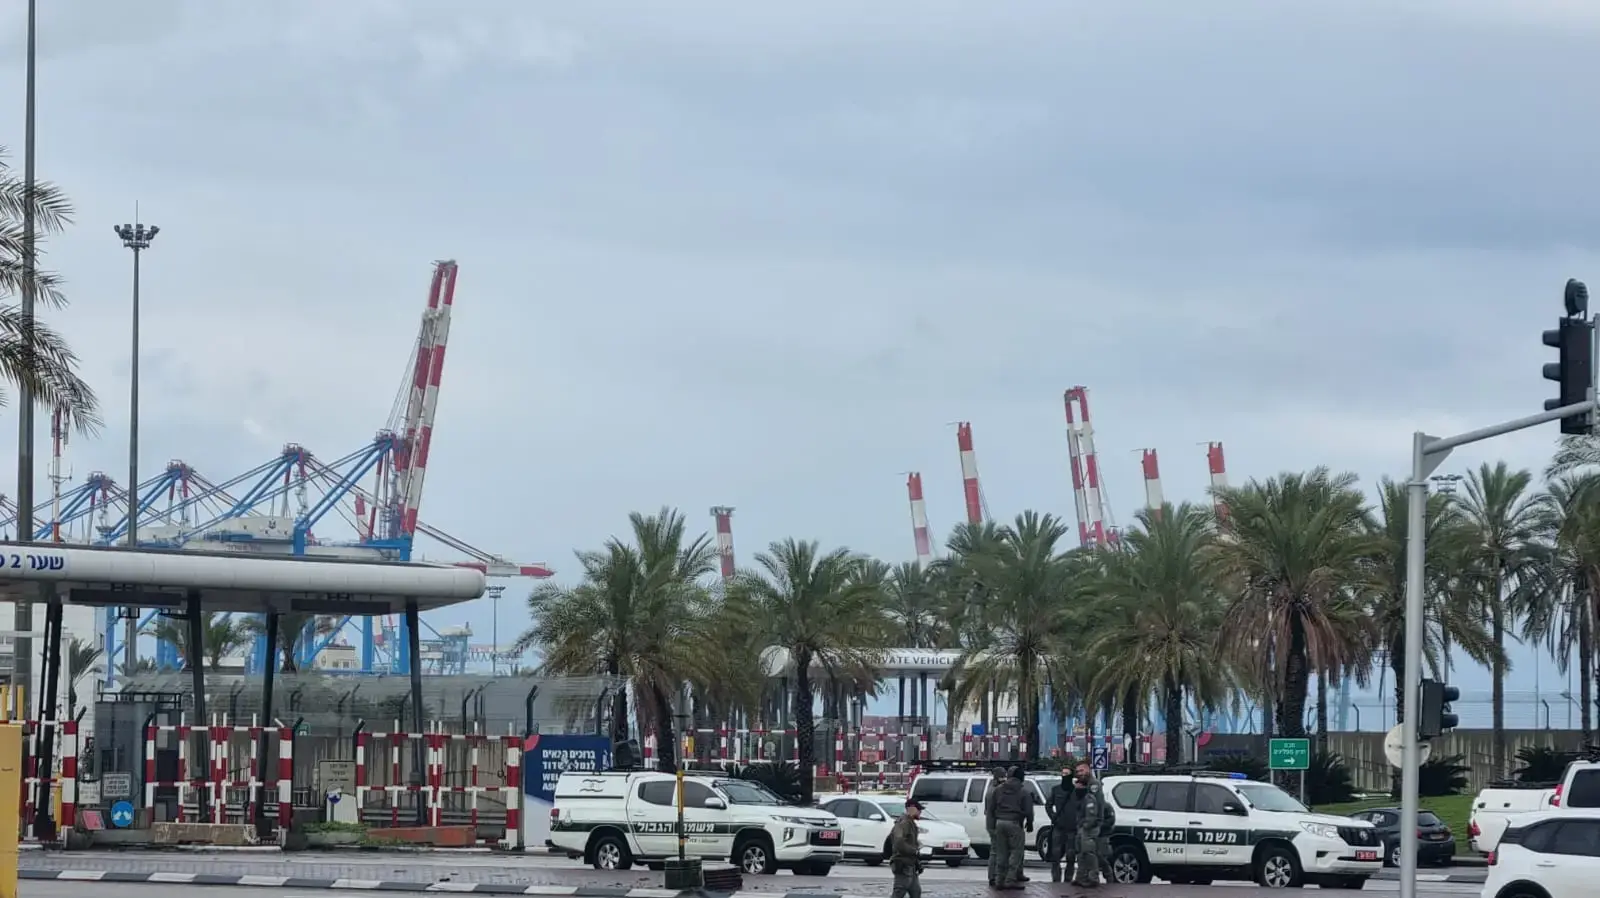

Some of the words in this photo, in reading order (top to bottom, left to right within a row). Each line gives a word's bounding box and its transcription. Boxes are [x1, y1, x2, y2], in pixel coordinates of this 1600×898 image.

[10, 554, 21, 569] 2
[27, 554, 65, 571] שער
[569, 750, 596, 759] ברוכים
[637, 822, 673, 832] הגבול
[1143, 827, 1184, 840] הגבול
[1196, 831, 1237, 843] משמר
